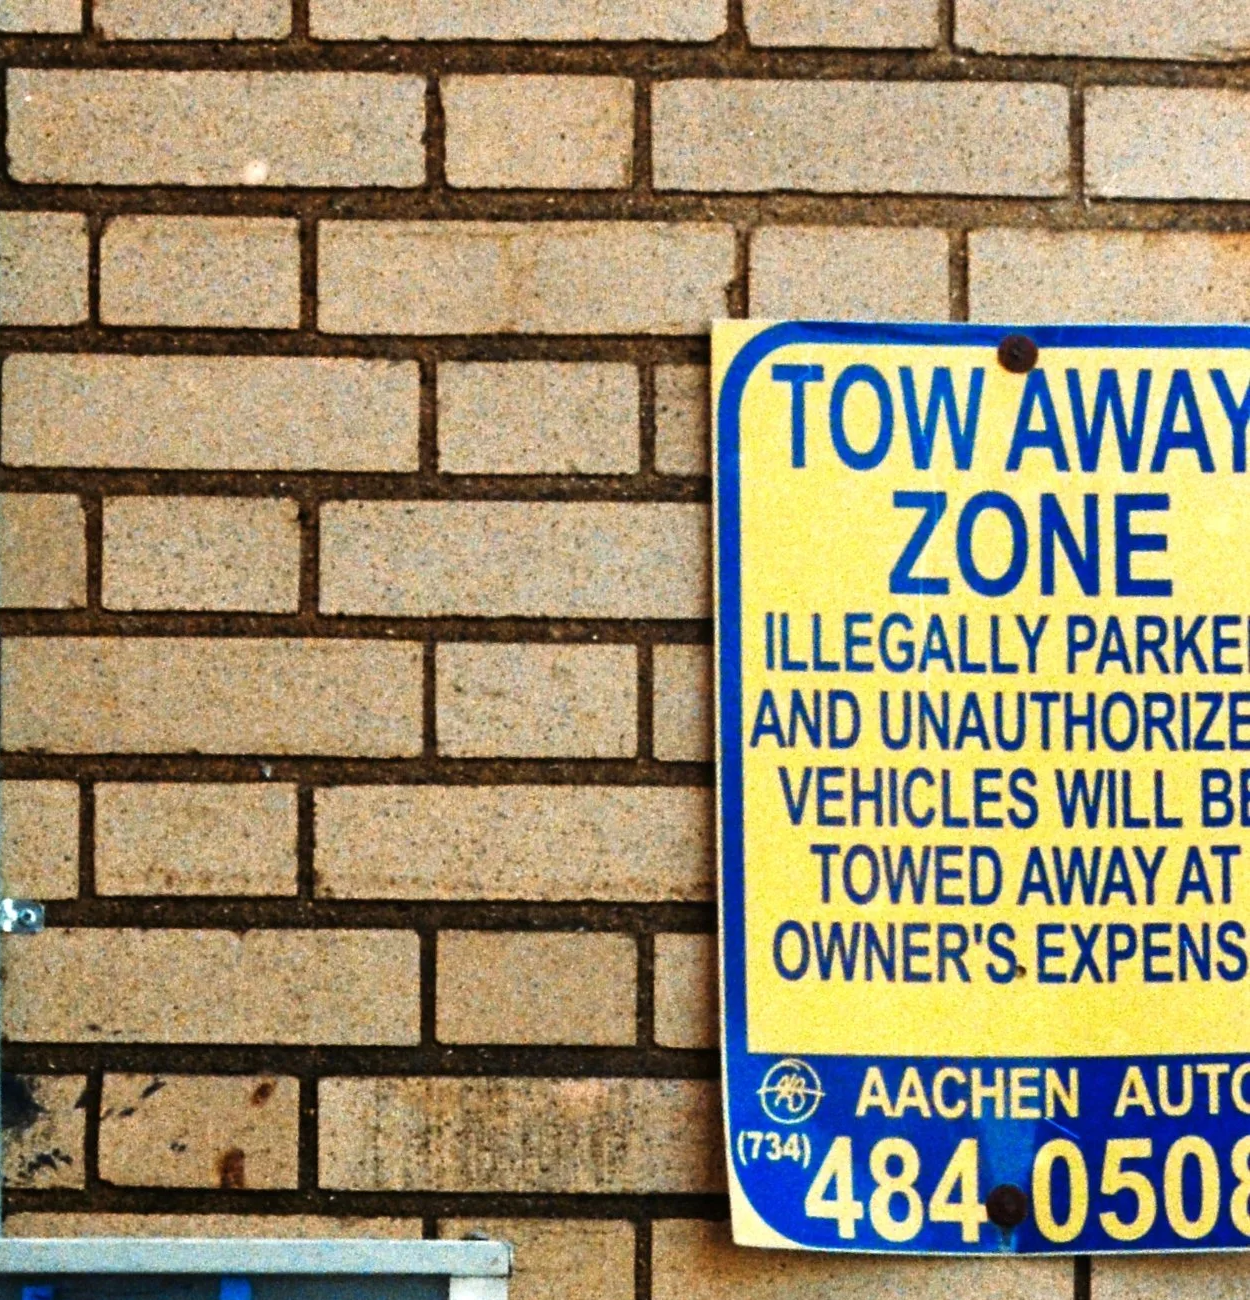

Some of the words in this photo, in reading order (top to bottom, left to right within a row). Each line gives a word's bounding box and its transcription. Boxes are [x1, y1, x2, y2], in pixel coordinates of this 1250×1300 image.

[772, 363, 985, 471] TOW
[1003, 365, 1250, 473] AWAY
[889, 490, 1173, 598] ZONE
[765, 612, 1048, 674] ILLEGALLY
[1067, 614, 1250, 675] PARKE
[750, 689, 860, 750] AND
[880, 690, 1250, 752] UNAUTHORIZE
[779, 766, 1039, 829] VEHICLES
[1056, 768, 1183, 829] WILL
[811, 844, 1002, 906] TOWED
[1017, 845, 1167, 906] AWAY
[1176, 844, 1241, 905] AT
[772, 919, 1016, 984] OWNER'S
[1037, 920, 1248, 984] EXPENS
[855, 1066, 1079, 1119] AACHEN
[737, 1130, 811, 1167] (734)
[804, 1135, 988, 1243] 484
